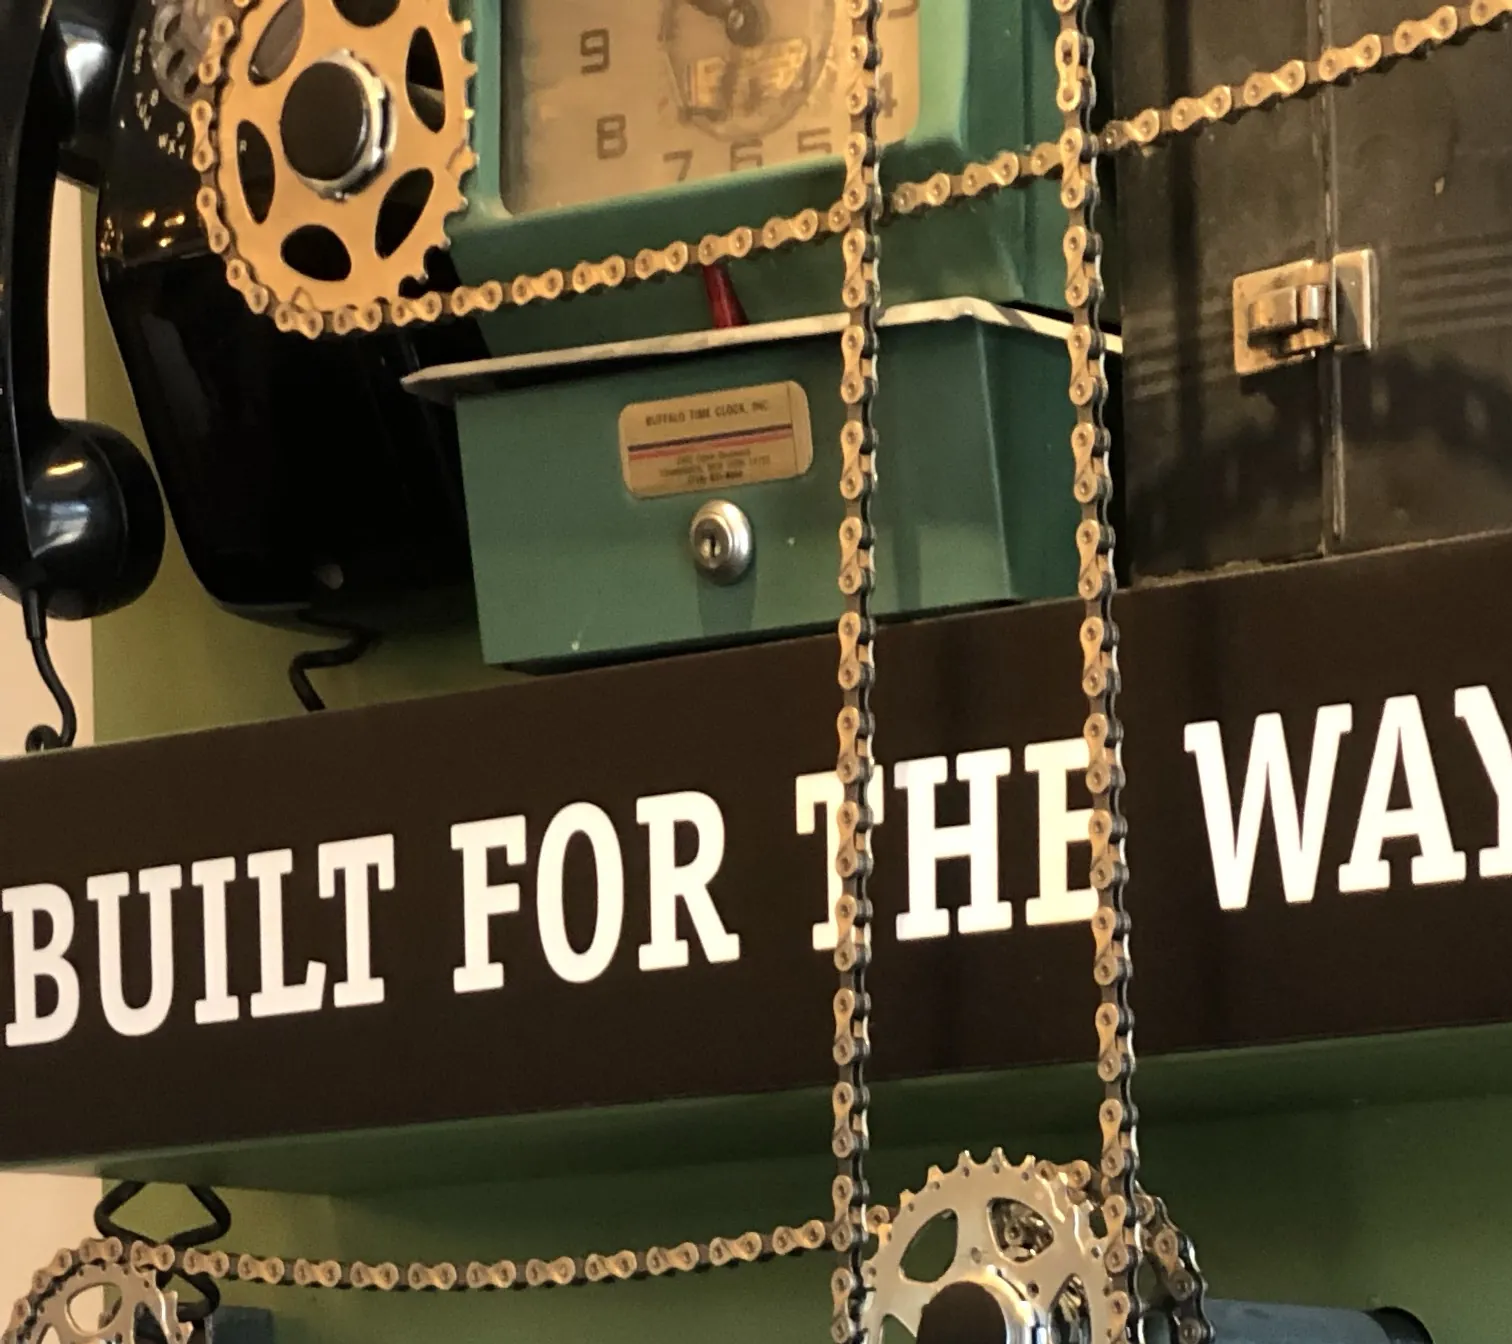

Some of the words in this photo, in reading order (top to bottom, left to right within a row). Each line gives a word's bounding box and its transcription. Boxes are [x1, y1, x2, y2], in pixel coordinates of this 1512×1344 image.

[579, 28, 610, 75] 9
[596, 113, 628, 160] 8
[663, 150, 693, 182] 7
[645, 410, 686, 426] BUFFALO
[689, 407, 711, 421] TIME
[2, 834, 395, 1047] BUILT
[450, 791, 740, 993] FOR
[796, 738, 1106, 950] THE
